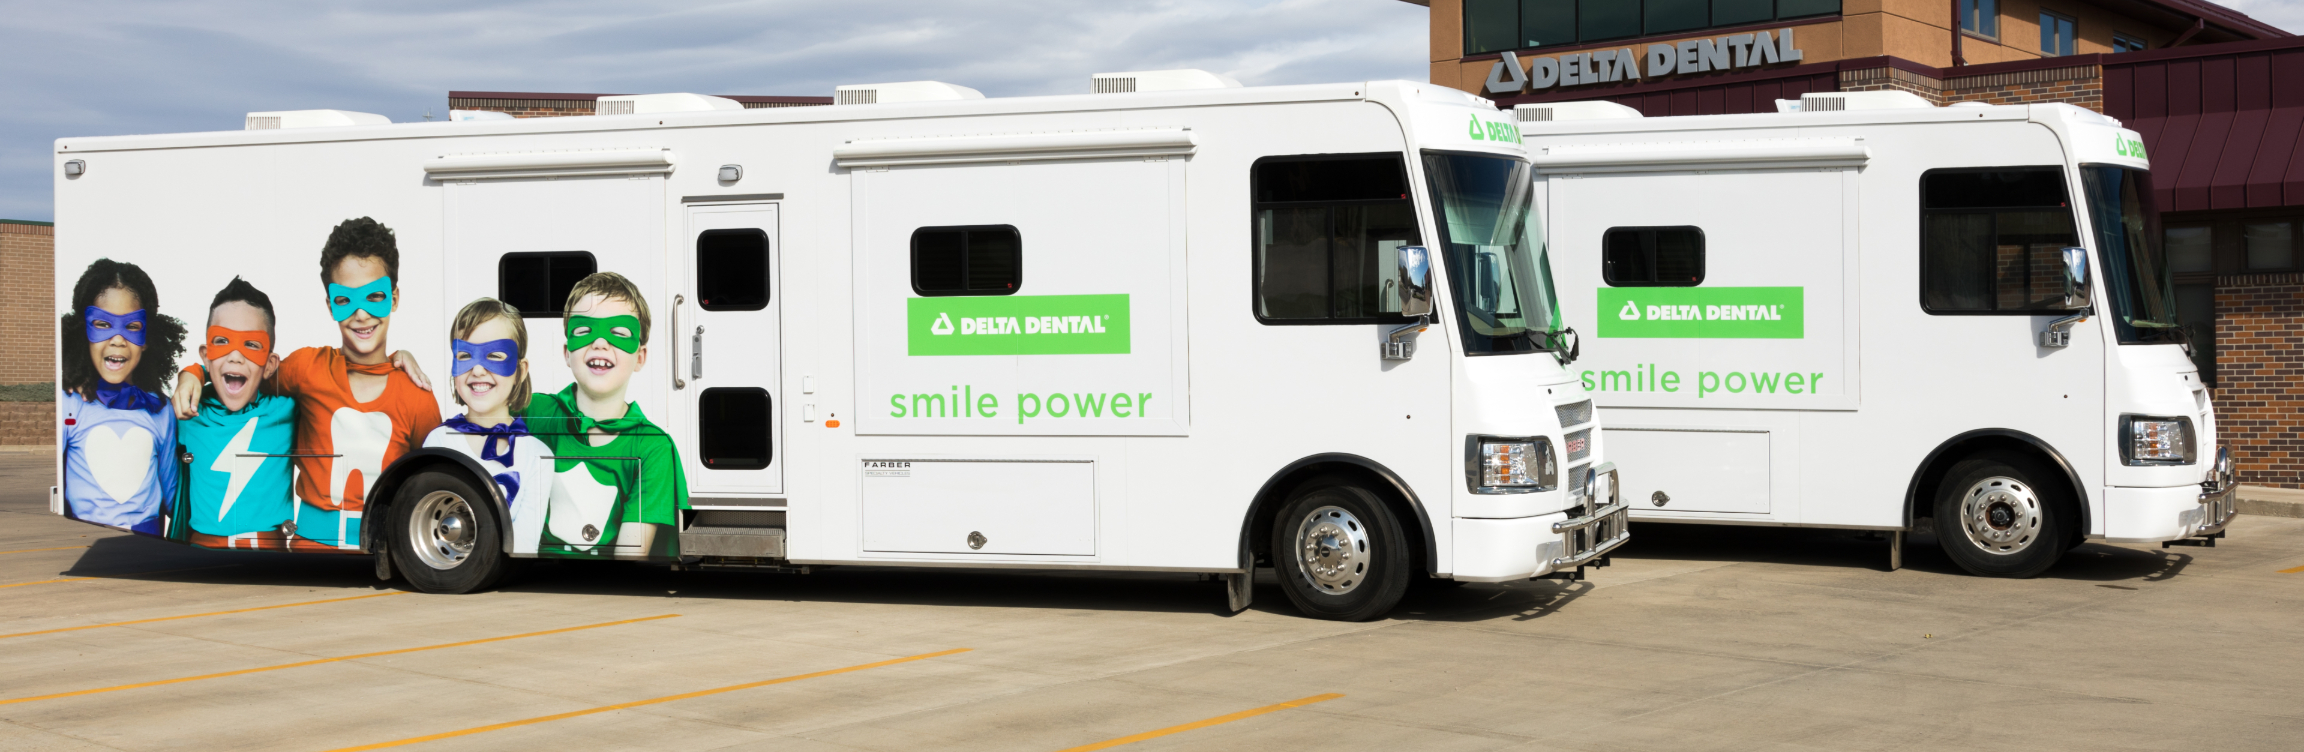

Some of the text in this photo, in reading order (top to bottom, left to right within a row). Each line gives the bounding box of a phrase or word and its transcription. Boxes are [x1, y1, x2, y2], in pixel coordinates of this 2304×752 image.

[1532, 28, 1803, 90] DELTA DENTAL
[1485, 120, 1518, 143] DELTA
[960, 317, 1021, 335] DELTA
[1646, 305, 1702, 320] DELTA
[1580, 363, 1824, 398] smile power
[890, 385, 1152, 424] smile power
